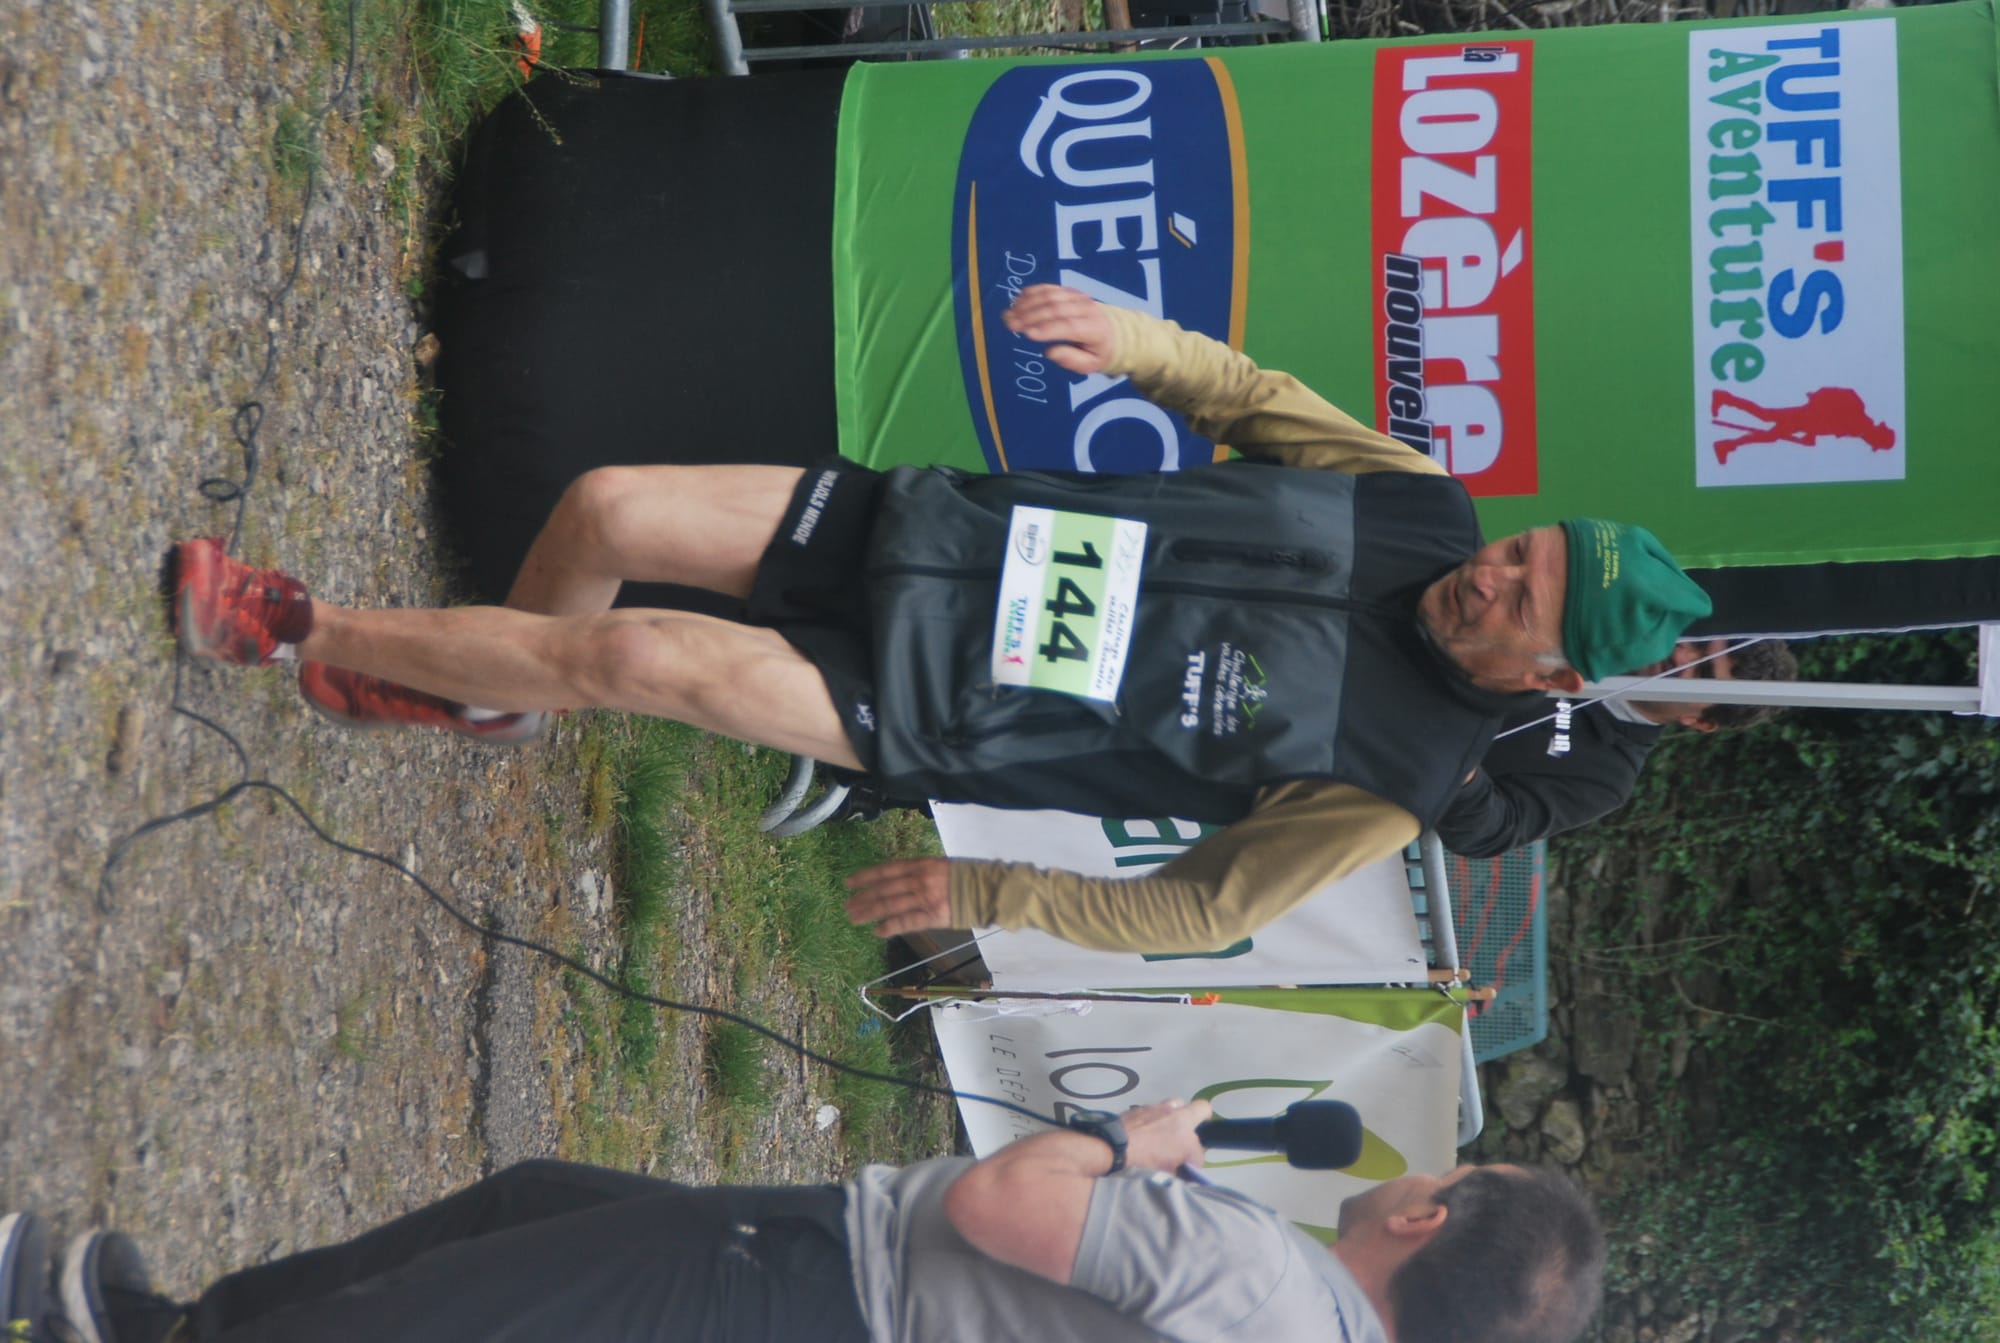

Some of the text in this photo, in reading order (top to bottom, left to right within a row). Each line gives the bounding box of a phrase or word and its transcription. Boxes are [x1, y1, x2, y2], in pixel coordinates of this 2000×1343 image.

[1463, 46, 1506, 62] la
[1707, 48, 1781, 382] Aventure
[1766, 28, 1845, 339] TUFF'S
[1400, 53, 1523, 475] Lozère
[1013, 348, 1048, 404] 1901
[1384, 254, 1434, 458] nouvell
[792, 506, 821, 545] MENDE
[1011, 597, 1028, 648] TUFF'S
[1038, 541, 1103, 663] 144
[1181, 651, 1206, 728] TUFF'S
[989, 1034, 1017, 1059] LE
